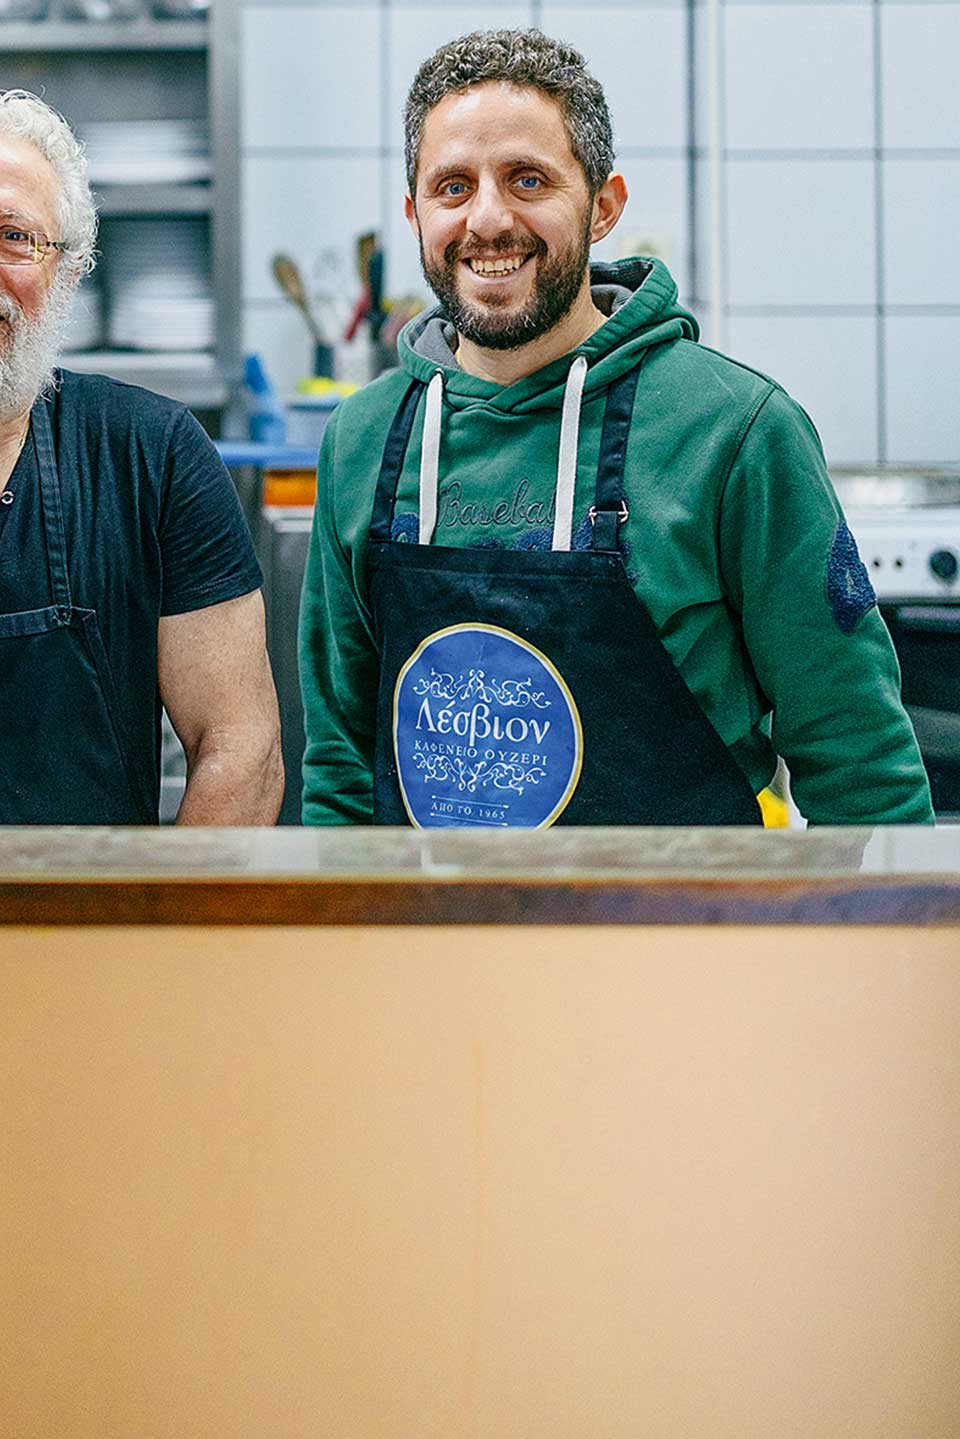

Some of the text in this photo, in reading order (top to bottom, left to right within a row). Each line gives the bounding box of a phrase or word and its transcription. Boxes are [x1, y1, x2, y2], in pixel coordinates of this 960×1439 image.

[415, 697, 551, 747] Λέσβιον
[414, 739, 548, 766] ΚΑΦΕΝΕΙΟ ΟΥΖΕΡΙ
[431, 802, 506, 820] ΑΠΟ ΤΟ 1965
